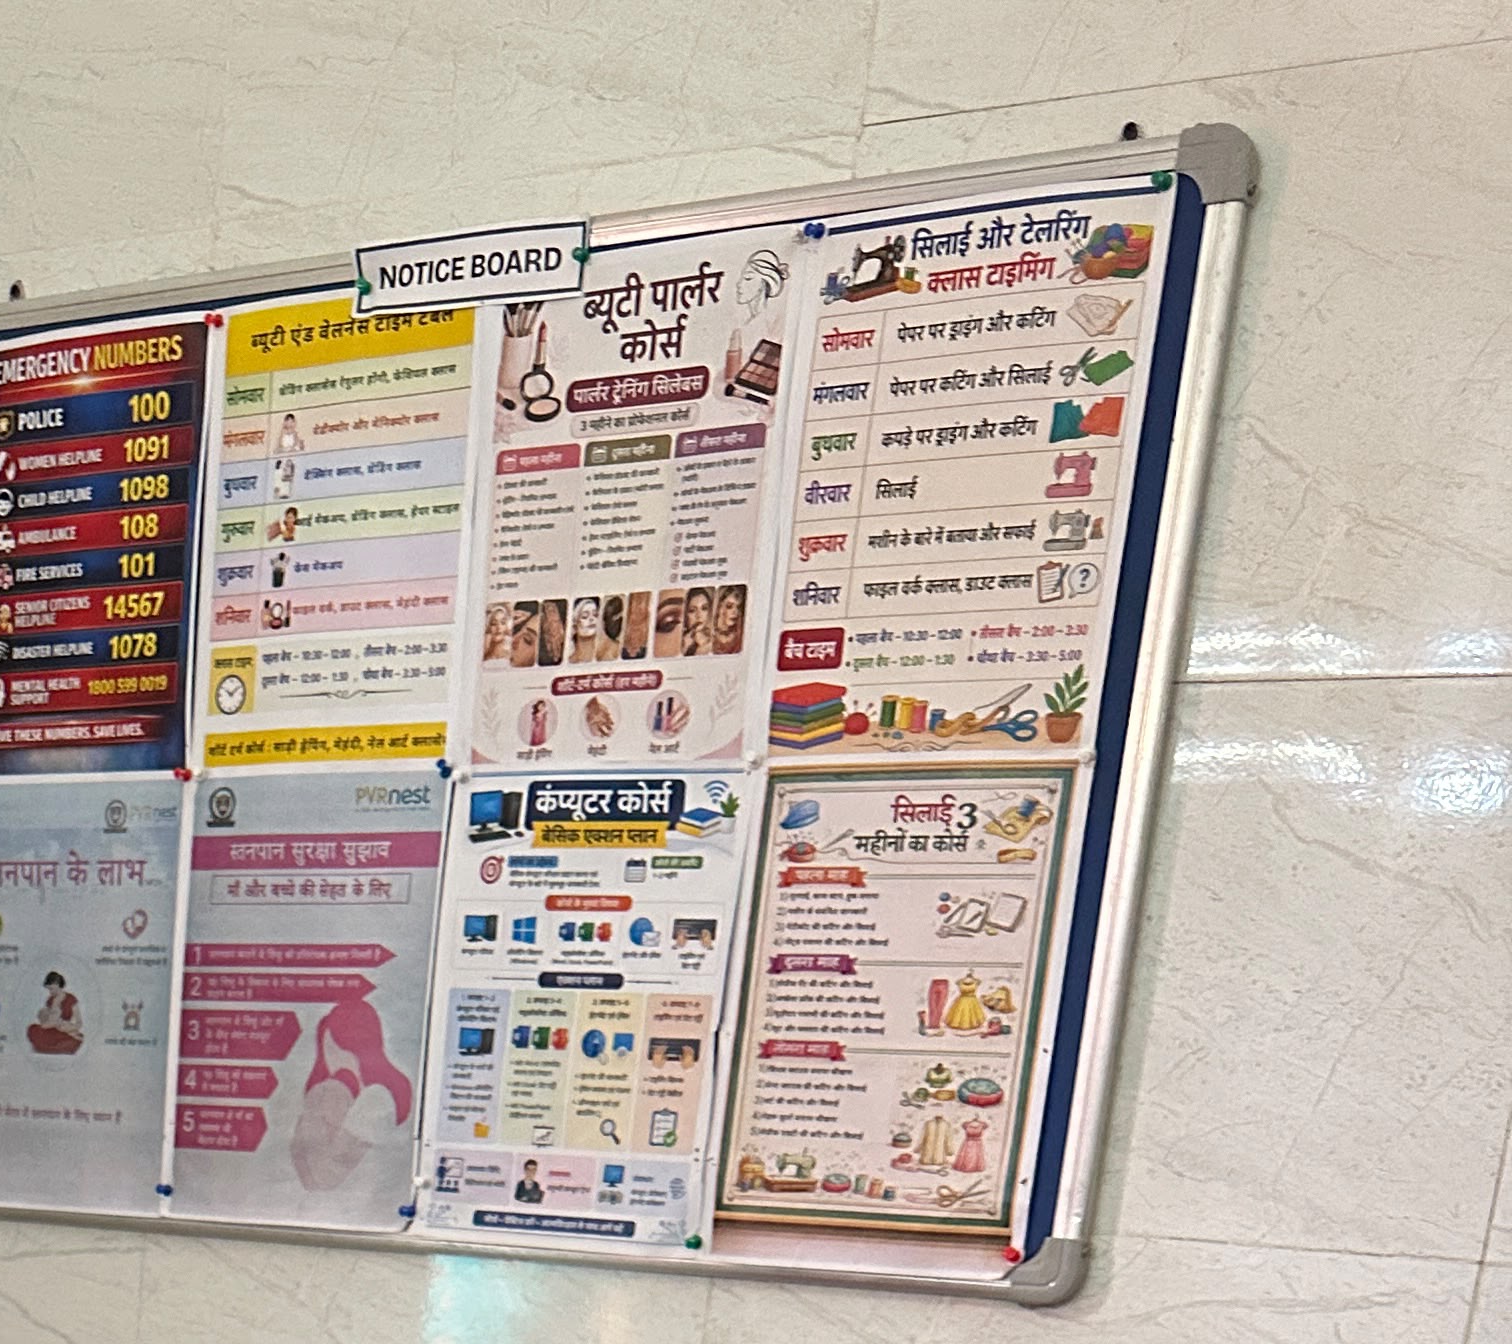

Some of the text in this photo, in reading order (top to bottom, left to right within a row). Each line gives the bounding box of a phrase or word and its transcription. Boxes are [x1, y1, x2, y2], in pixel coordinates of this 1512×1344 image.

[911, 210, 1091, 260] सिलाई और टेलरिंग
[379, 246, 562, 289] NOTICE BOARD
[927, 252, 1057, 294] क्लास टाइमिंग
[583, 262, 724, 333] ब्यूटी पार्लर
[250, 330, 287, 354] ब्यूटी
[290, 323, 315, 347] एंड
[319, 317, 369, 340] वेलनेस
[620, 315, 688, 362] कोर्स
[822, 328, 875, 353] सोमवार
[897, 319, 925, 343] पेपर
[927, 321, 946, 338] पर
[985, 312, 1013, 333] और
[1015, 307, 1057, 330] कटिंग
[93, 335, 183, 371] NUMBERS
[573, 385, 610, 405] पार्लर
[813, 359, 1053, 405] मंगलवार पेपर पर कटिंग और सिलाई
[17, 391, 170, 432] POLICE 100
[18, 435, 169, 471] WOMEN HELPLINE 1091
[811, 431, 857, 461] बुधवार
[916, 424, 935, 444] पर
[970, 418, 998, 440] और
[18, 474, 169, 508] CHILD HELPLINE 1098
[805, 475, 919, 505] वीरवार सिलाई
[18, 513, 159, 545] AMBULANCE 108
[798, 534, 848, 561] शुक्रवार
[15, 552, 155, 582] FIRE SERVICES 101
[15, 597, 91, 614] SENIOR CITIZENS
[104, 592, 165, 620] 14567
[793, 581, 841, 606] शनिवार
[12, 632, 158, 660] DISASTER HELPLINE 1078
[10, 677, 81, 693] MENTAL HEALTH
[10, 691, 50, 706] SUPPORT
[14, 728, 42, 743] THESE
[93, 724, 115, 740] SAVE
[536, 781, 673, 822] कंप्यूटर कोर्स
[891, 794, 977, 829] सिलाई 3
[230, 842, 285, 861] स्तनपान
[907, 835, 929, 852] का
[932, 829, 969, 853] कोर्स
[66, 850, 89, 886] के
[98, 859, 147, 887] लाभ
[191, 977, 201, 997] 2
[188, 1020, 200, 1040] 3
[184, 1069, 197, 1090] 4
[182, 1112, 195, 1131] 5
